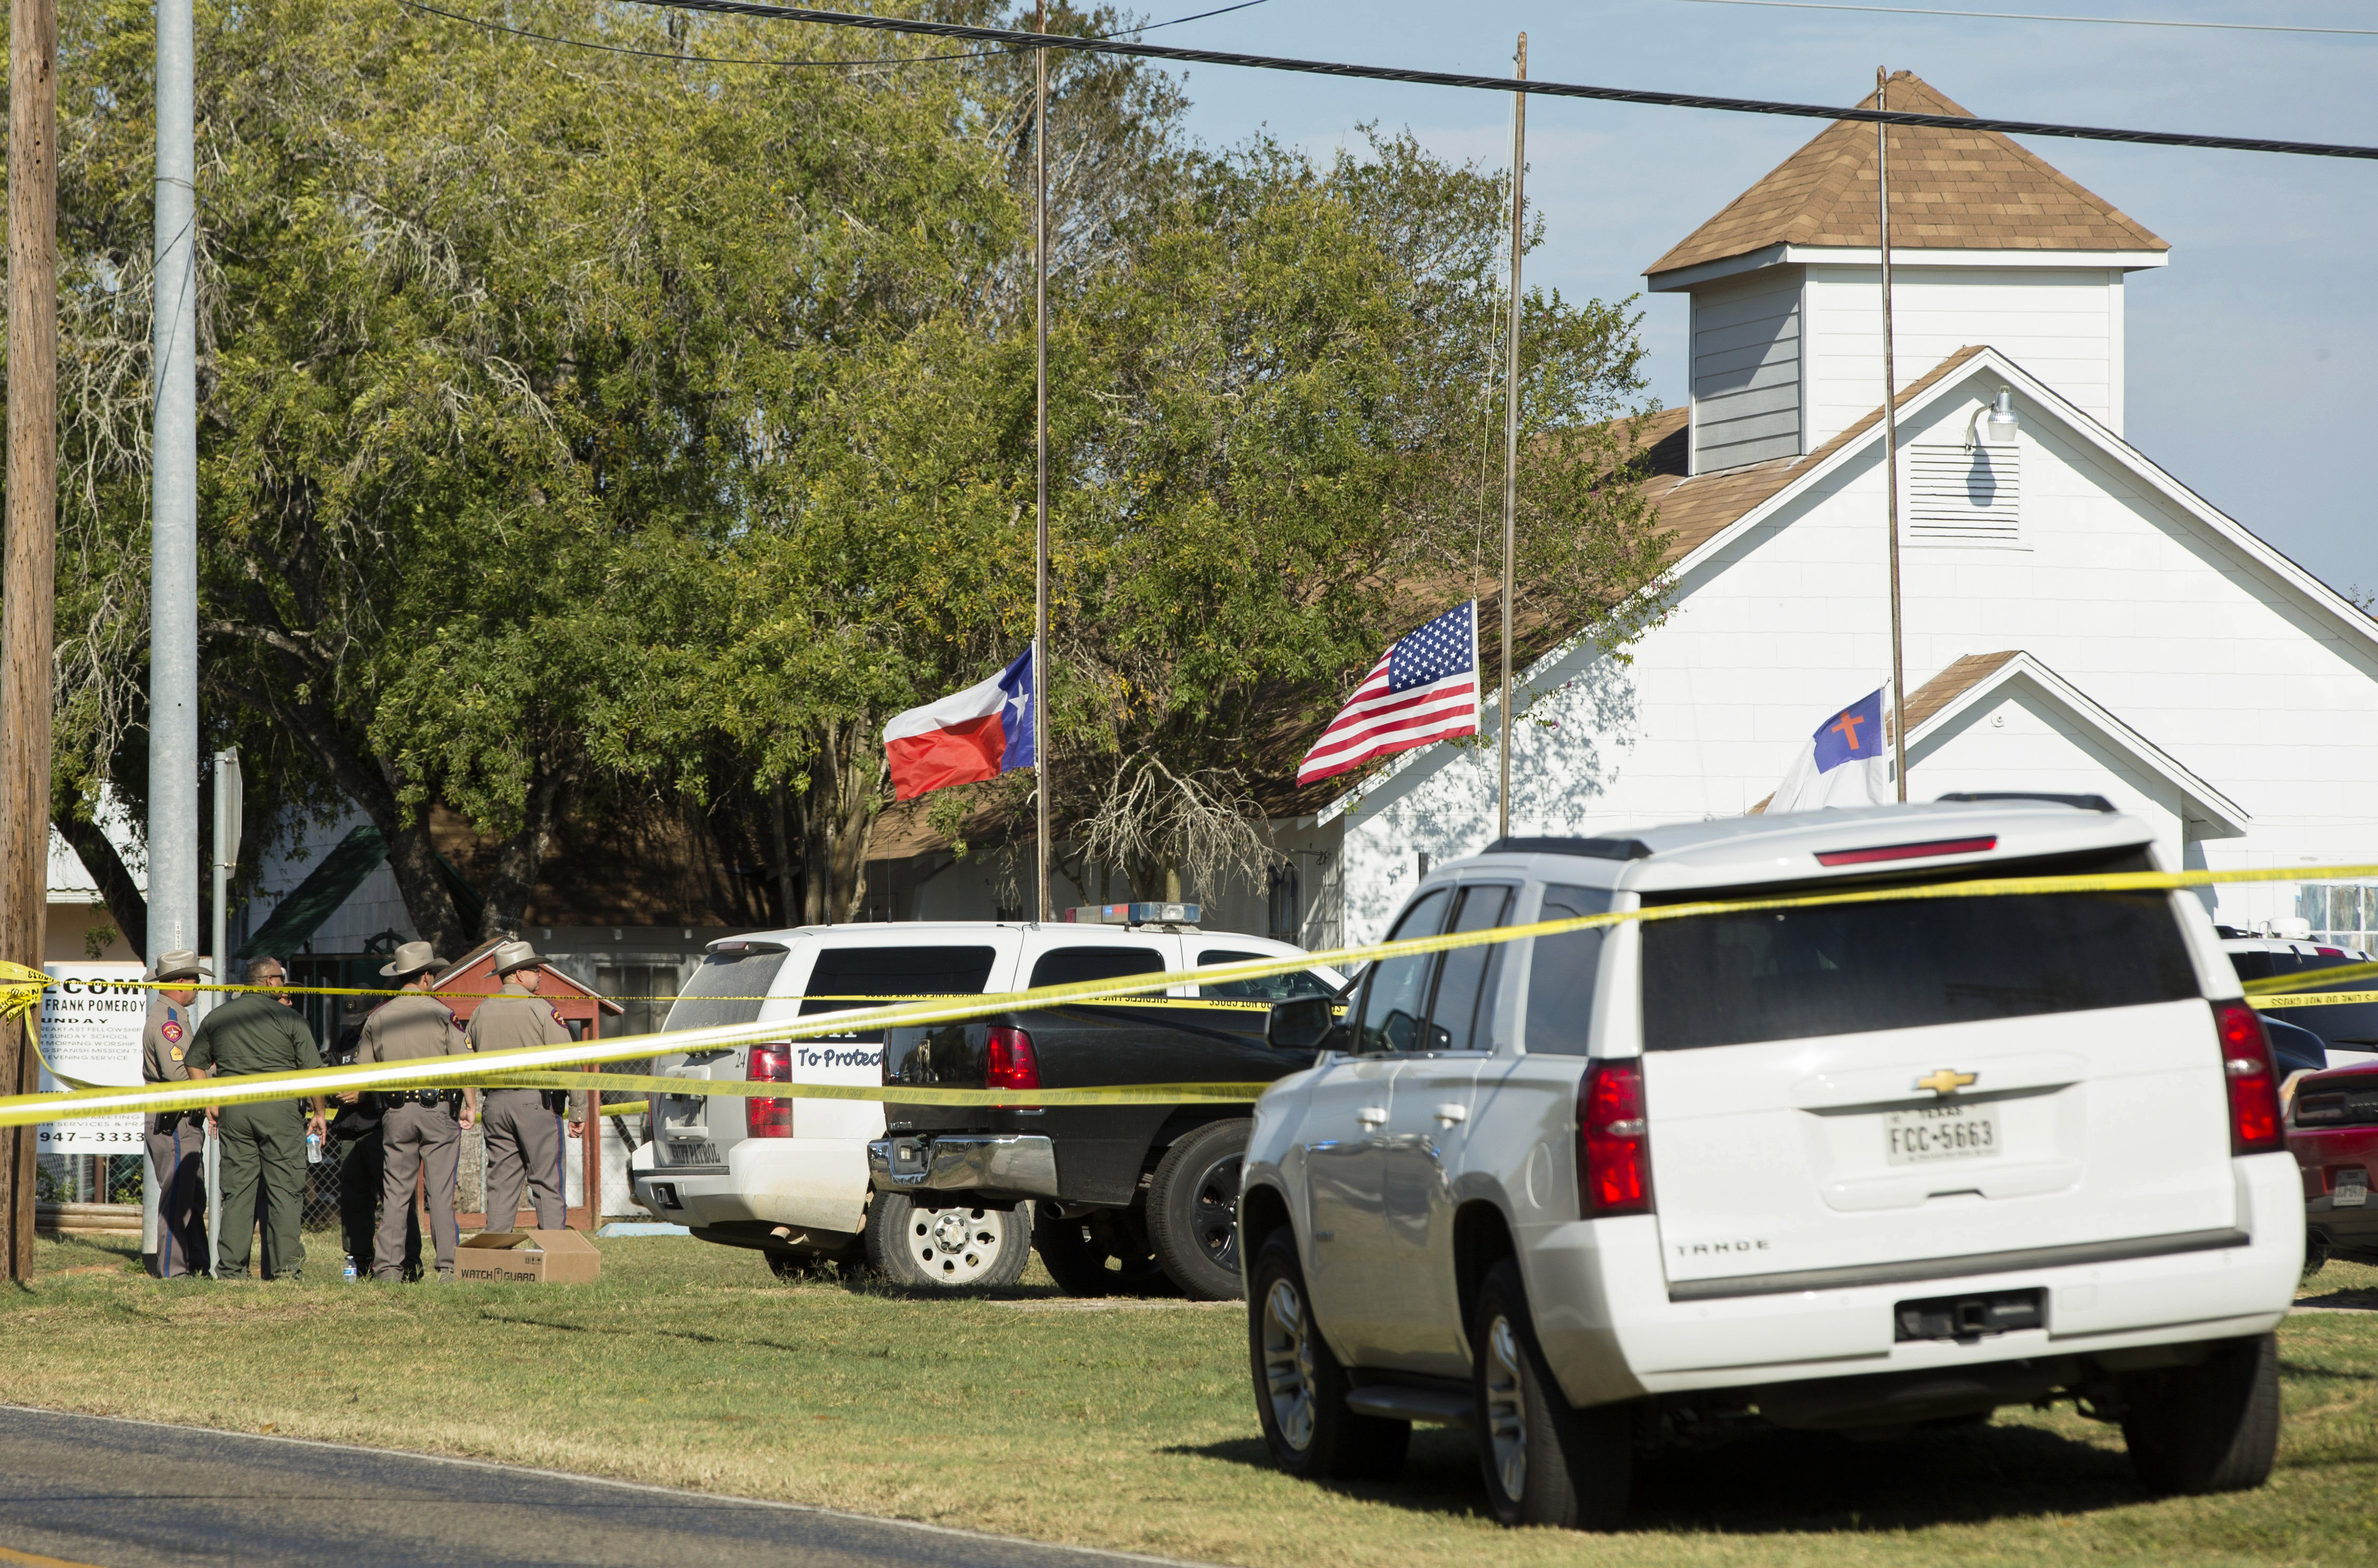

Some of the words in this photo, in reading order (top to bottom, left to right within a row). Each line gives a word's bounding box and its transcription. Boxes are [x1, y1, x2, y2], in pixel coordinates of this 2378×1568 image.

[43, 978, 146, 994] LCOM
[45, 999, 84, 1011] FRANK
[89, 1000, 145, 1012] POMEROY
[735, 1052, 746, 1068] 24
[798, 1048, 822, 1066] To
[688, 1143, 721, 1164] PATROL
[1676, 1239, 1770, 1256] TAHOE
[461, 1268, 493, 1280] WATCH
[504, 1272, 535, 1282] GUARD
